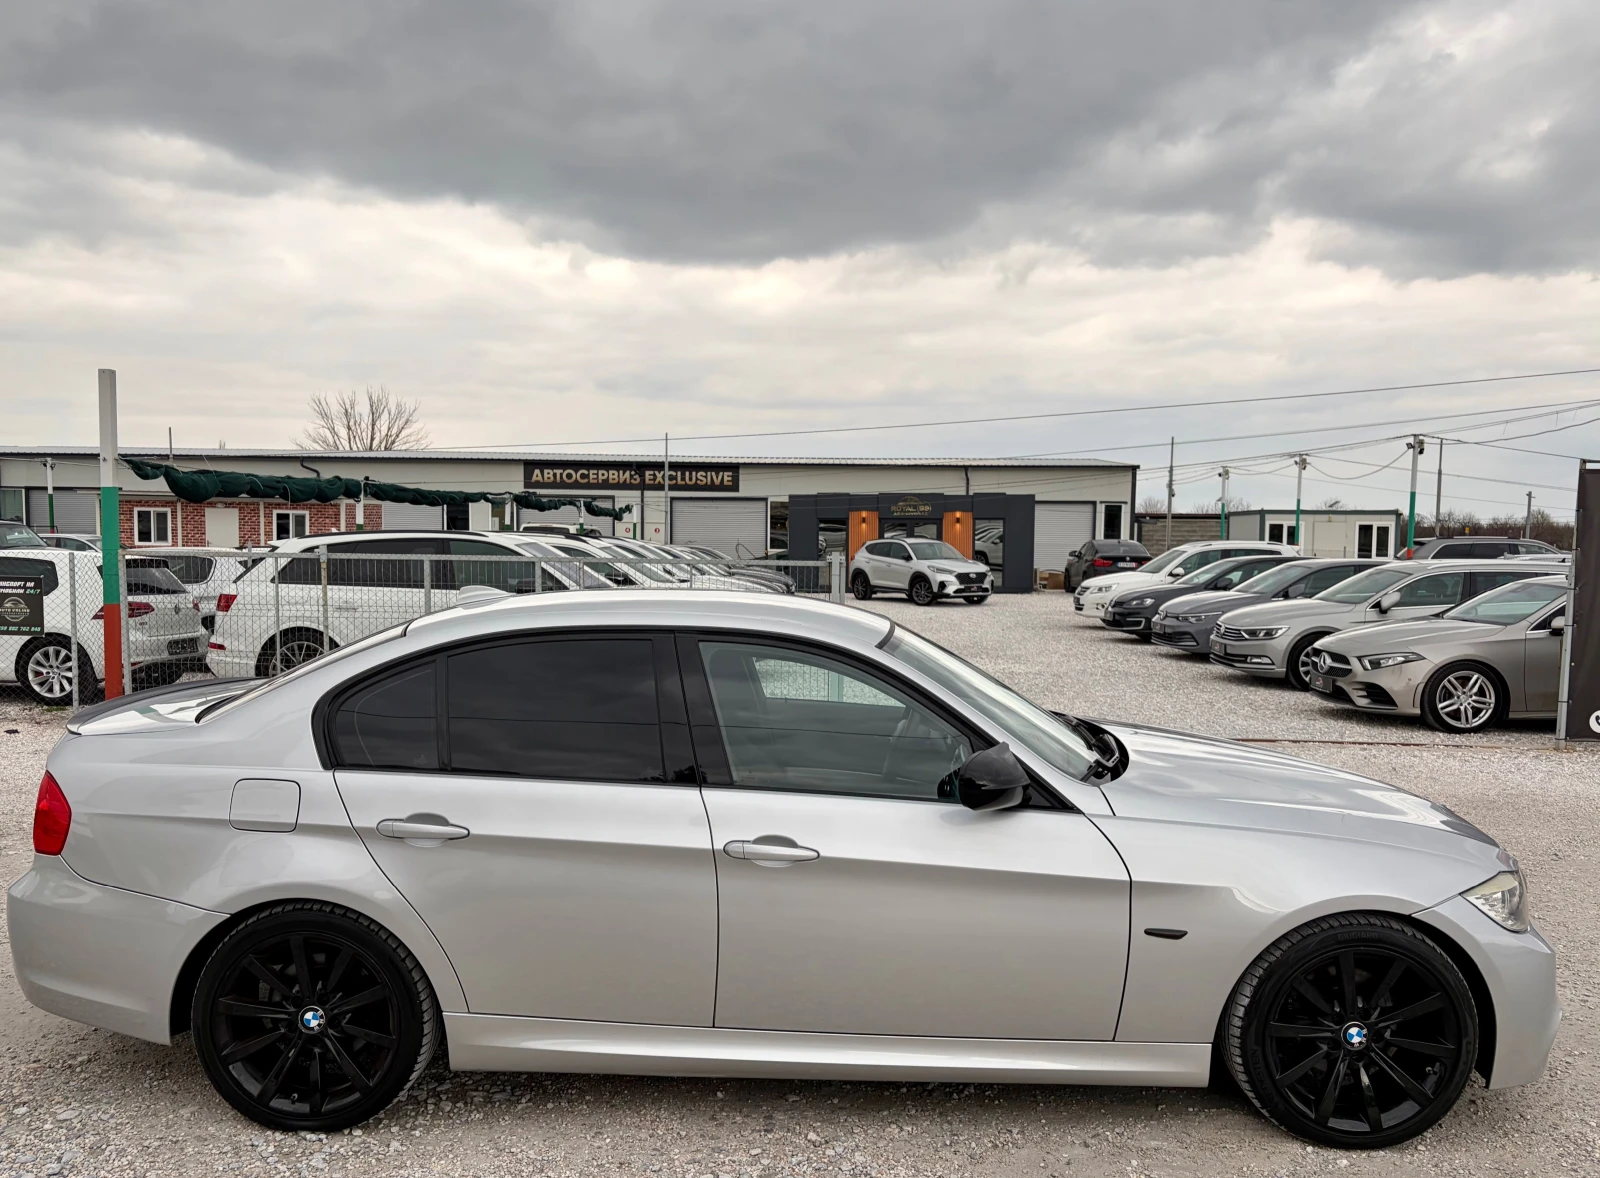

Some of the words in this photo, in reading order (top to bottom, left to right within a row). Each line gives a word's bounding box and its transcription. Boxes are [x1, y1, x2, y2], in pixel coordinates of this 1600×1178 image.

[531, 468, 641, 484] АВТОСЕРВИЗ
[645, 470, 733, 486] EXCLUSIVE
[1336, 930, 1379, 941] GIUGIARO
